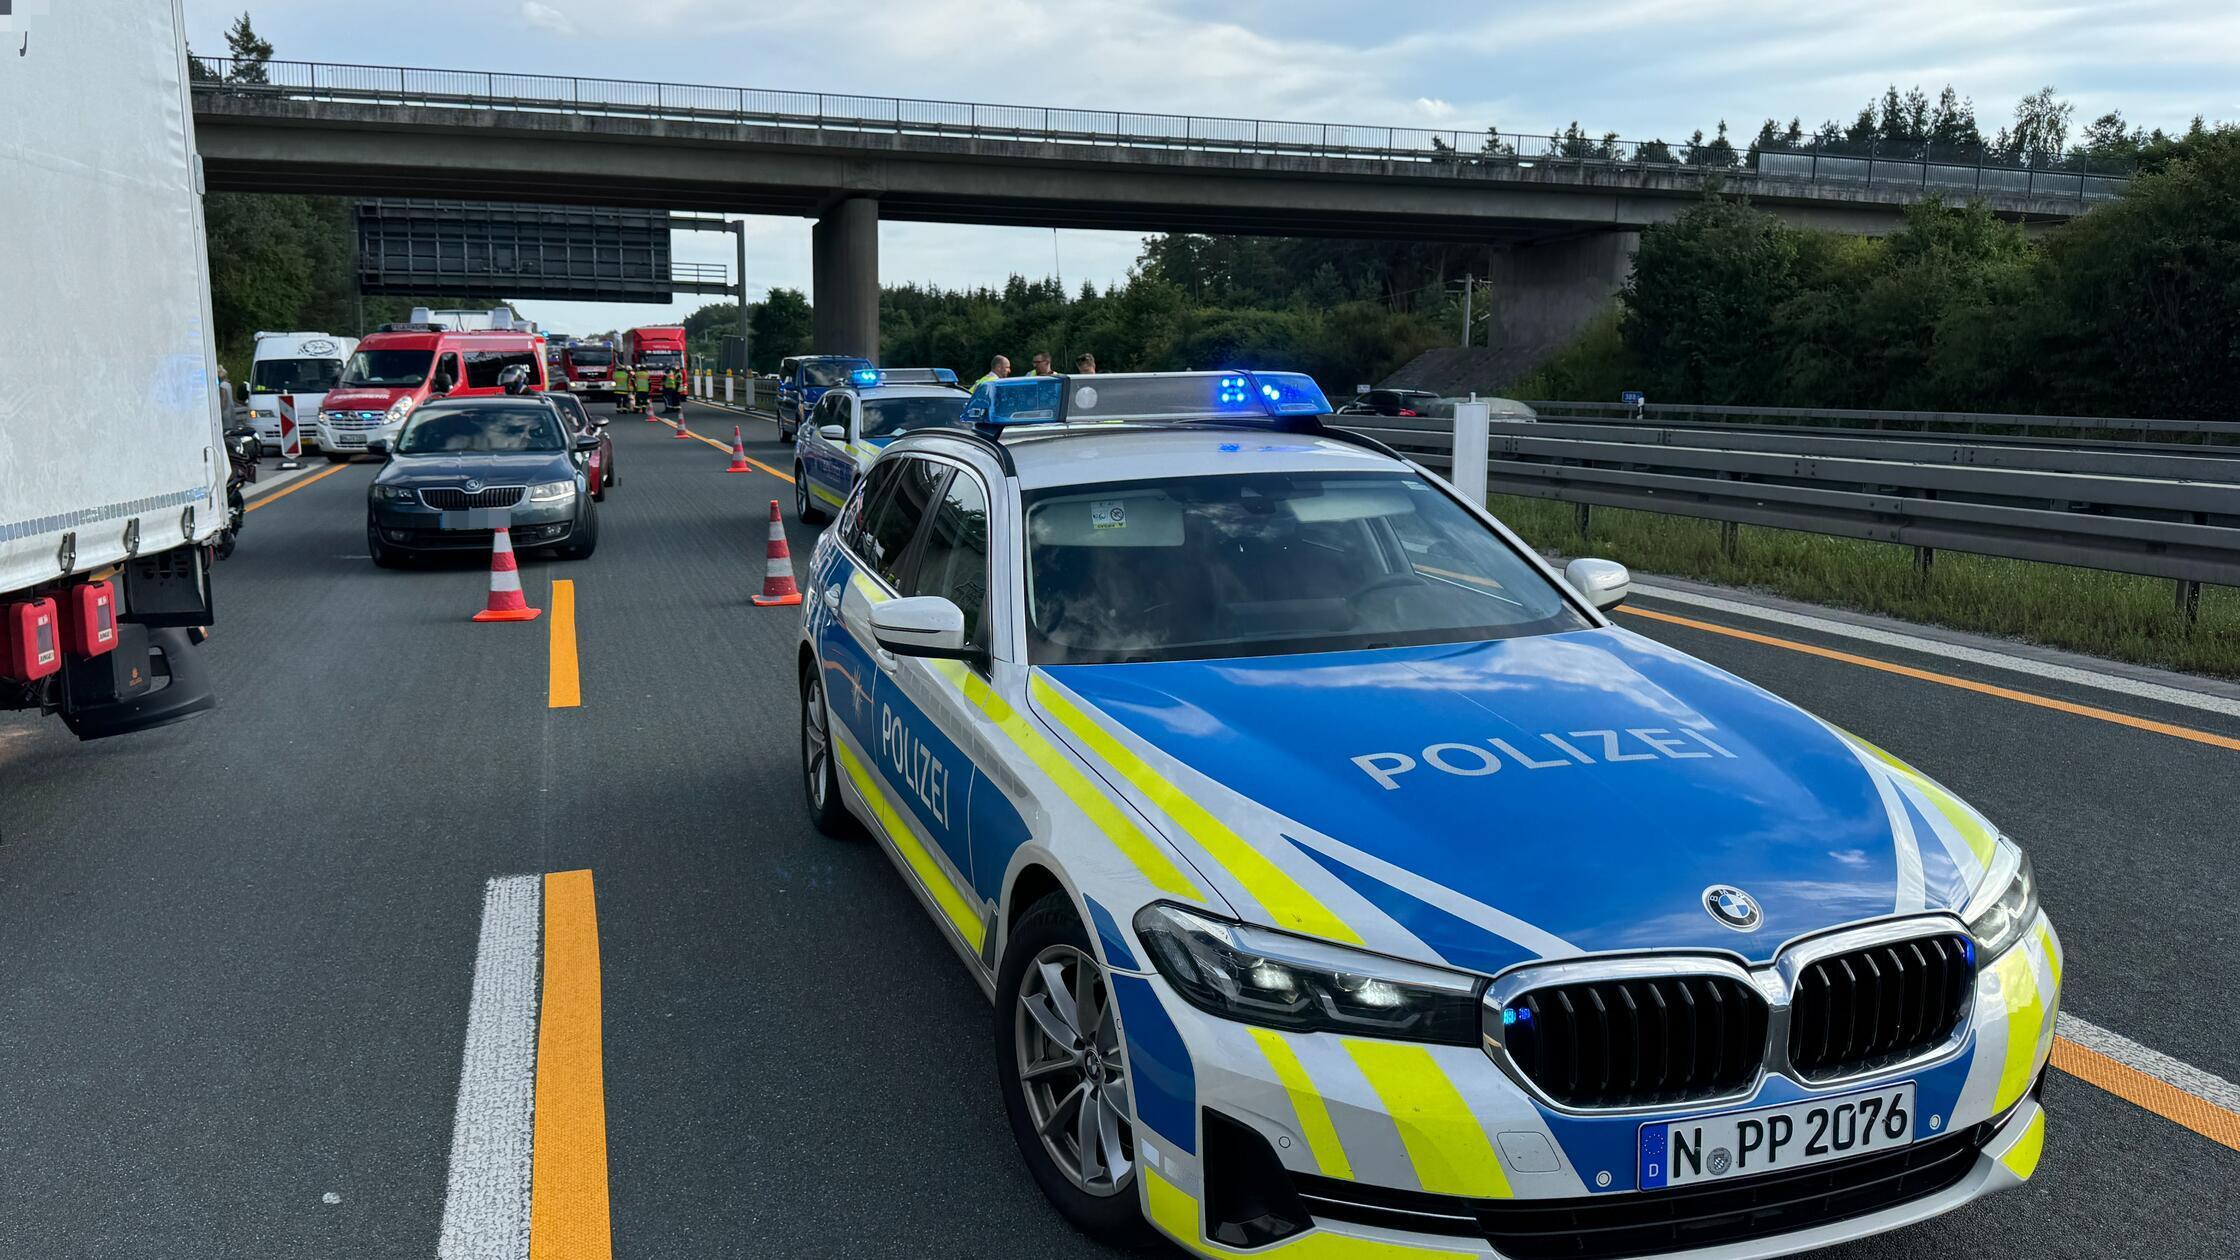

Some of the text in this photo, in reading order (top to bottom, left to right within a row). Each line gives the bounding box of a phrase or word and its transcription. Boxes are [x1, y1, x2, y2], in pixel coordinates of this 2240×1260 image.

[882, 702, 949, 831] POLIZEI
[1350, 728, 1738, 790] POLIZEI
[1648, 1163, 1659, 1177] D
[1673, 1093, 1908, 1178] N PP 2076
